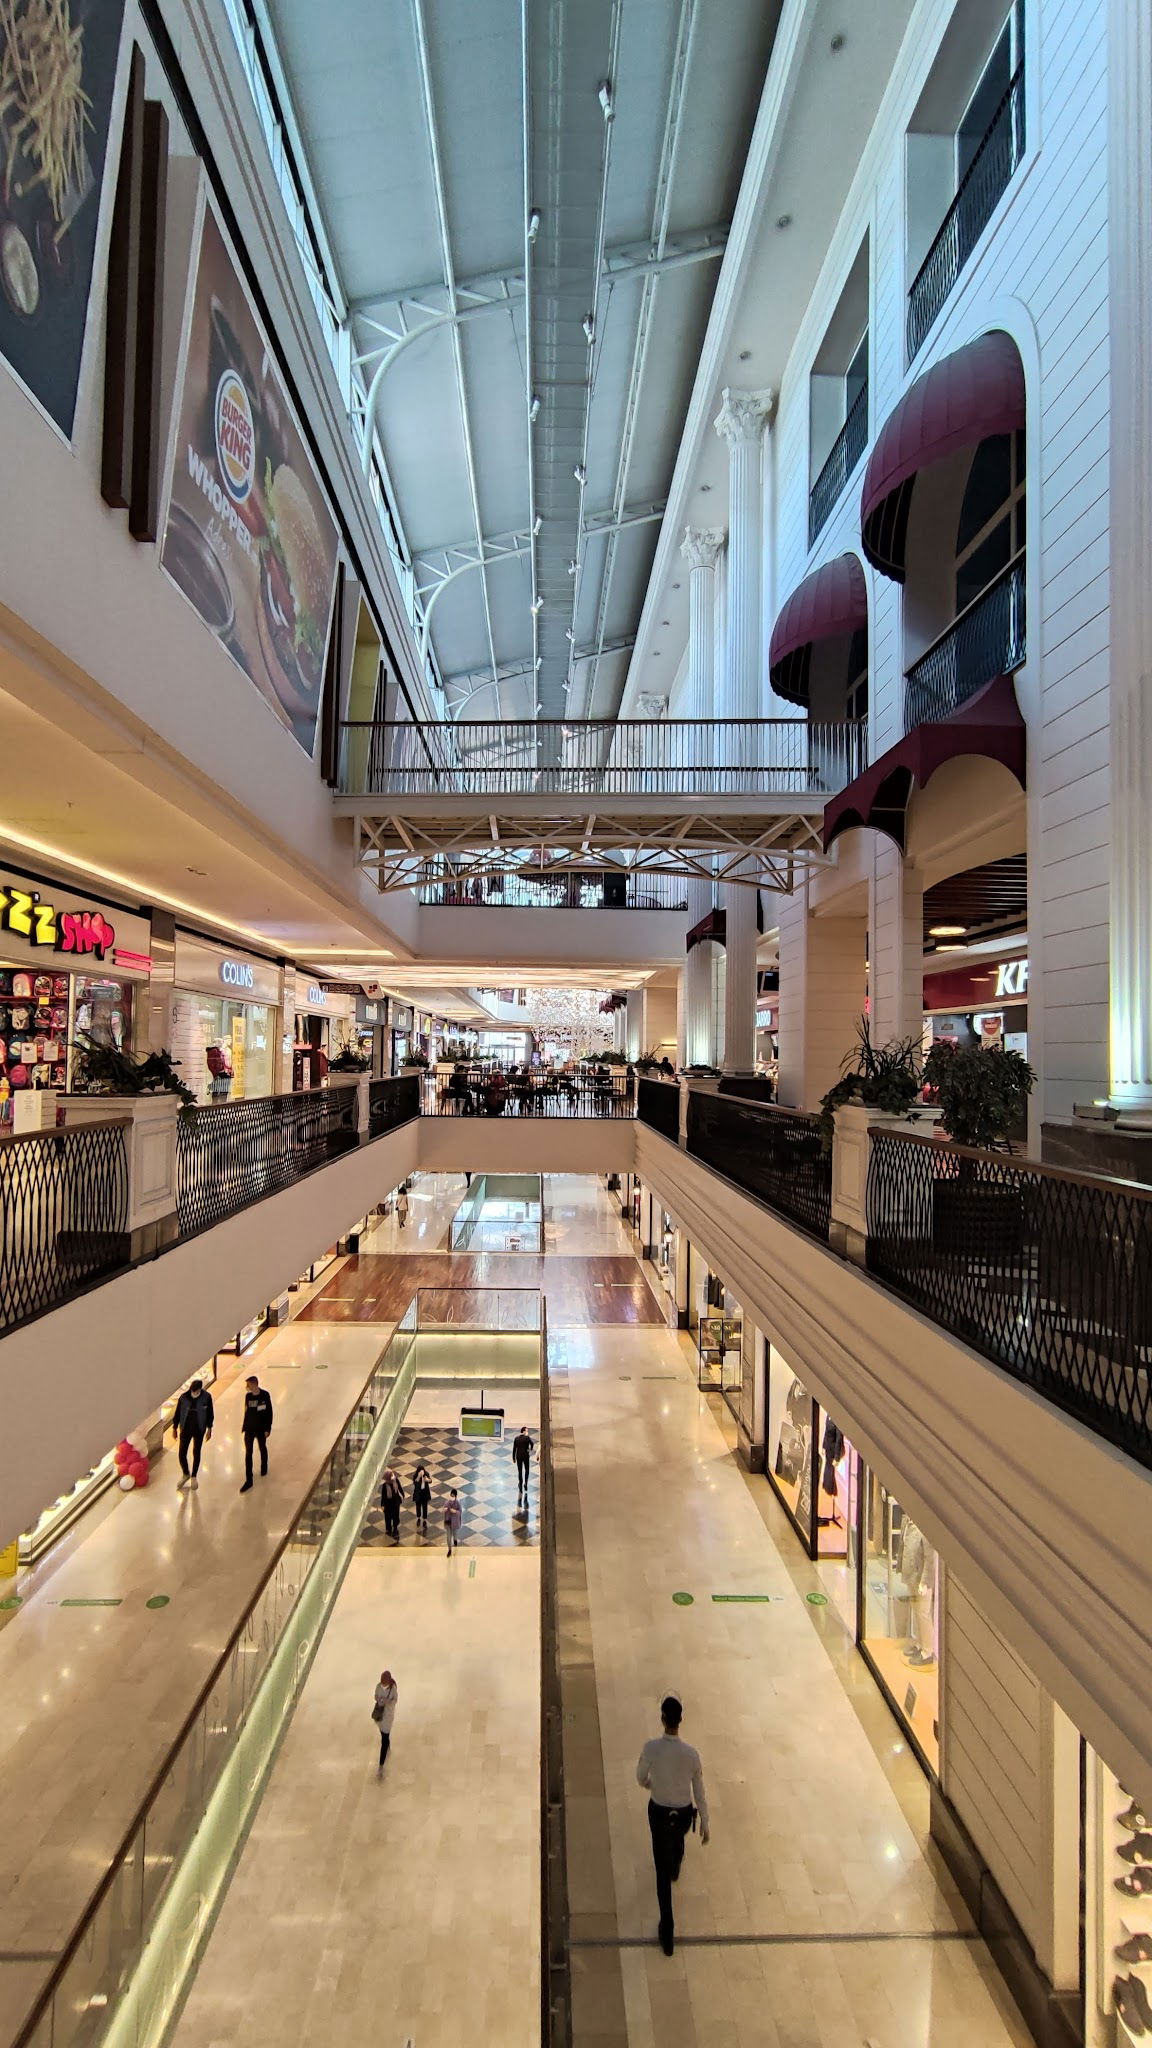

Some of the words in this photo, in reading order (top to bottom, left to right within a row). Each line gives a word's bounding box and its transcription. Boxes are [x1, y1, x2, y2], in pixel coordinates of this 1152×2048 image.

[222, 397, 251, 440] BURGER
[219, 420, 251, 470] KING
[187, 444, 253, 553] WHOPPER
